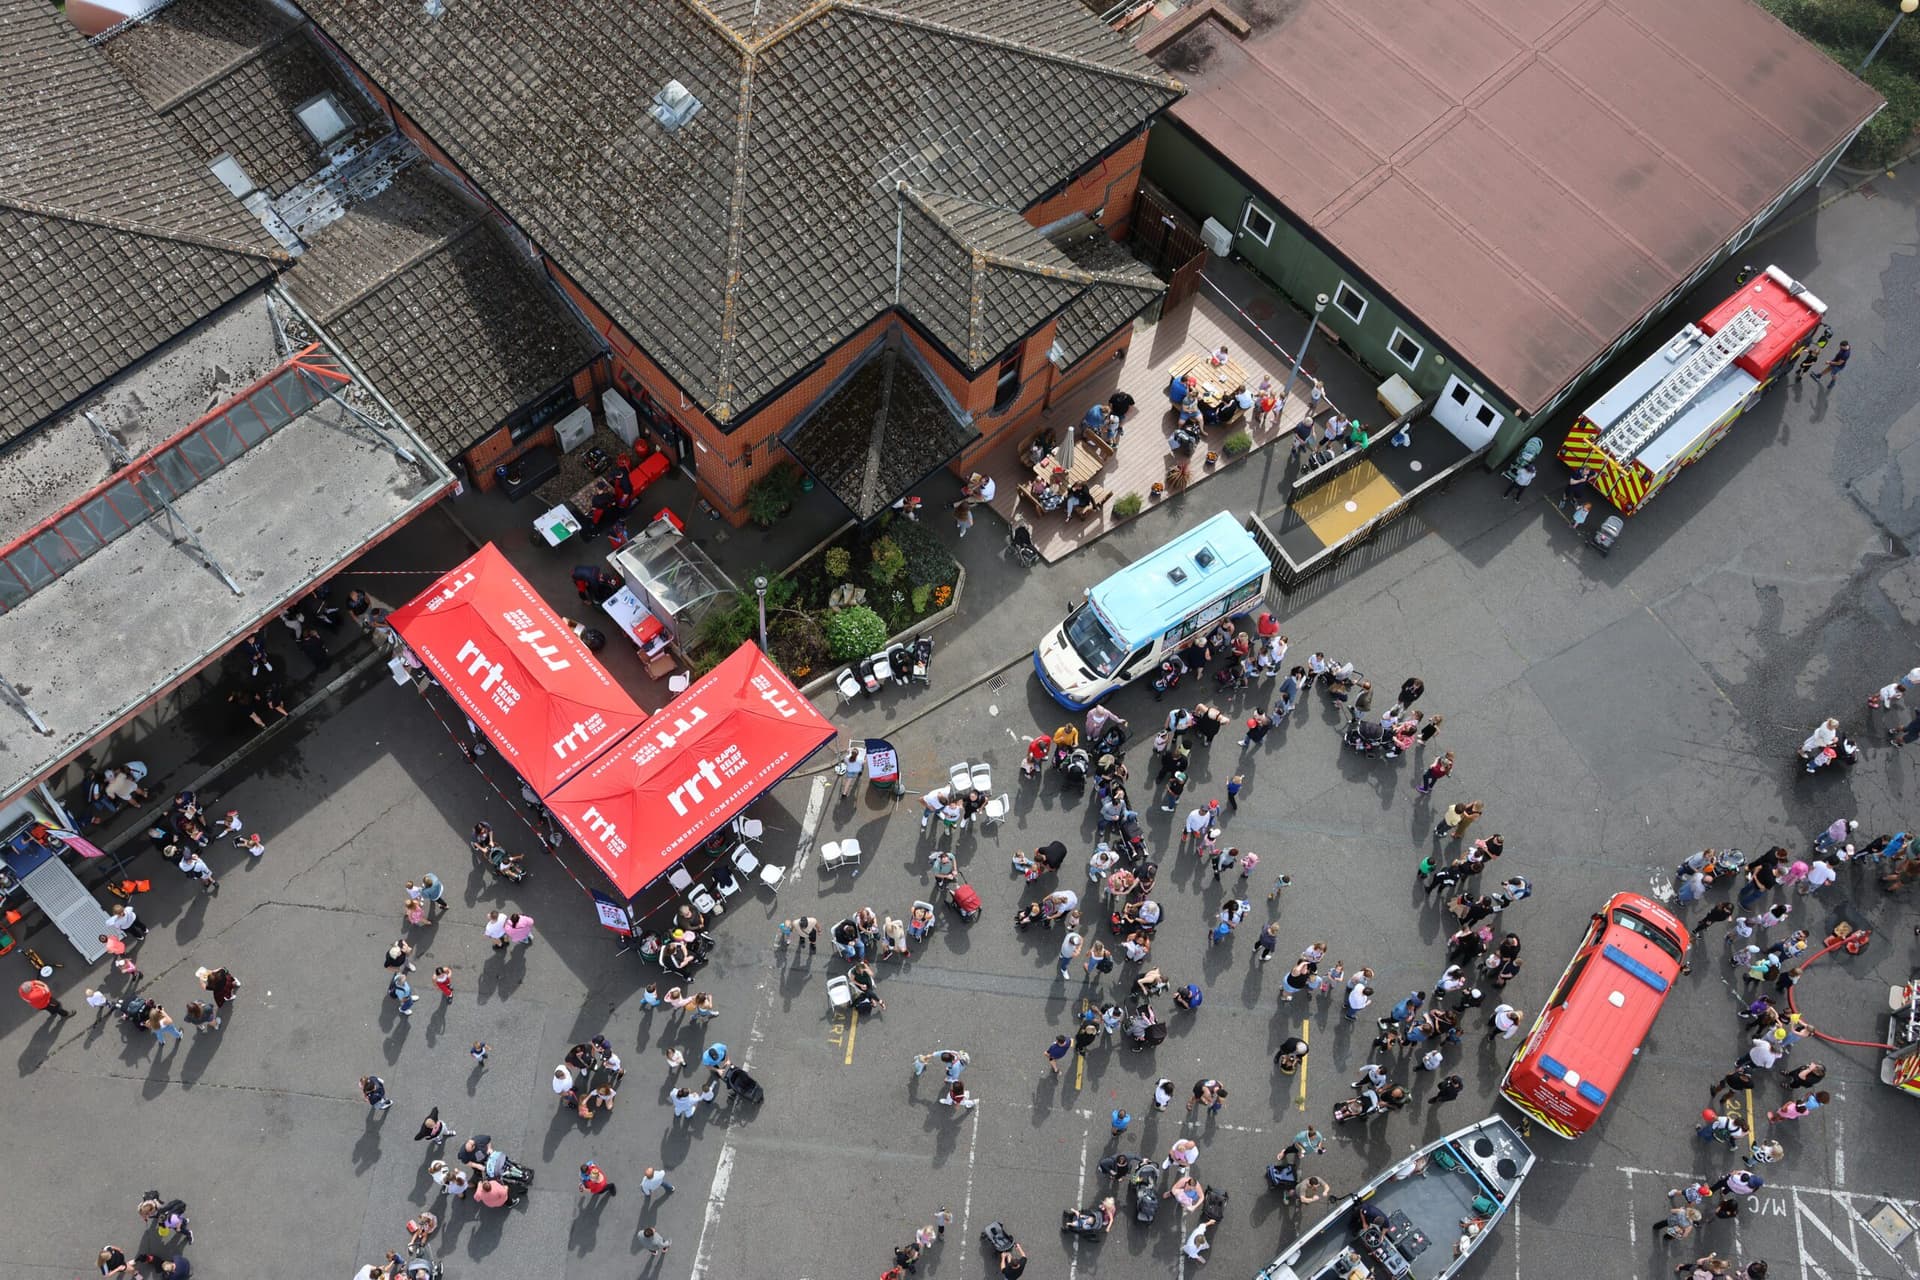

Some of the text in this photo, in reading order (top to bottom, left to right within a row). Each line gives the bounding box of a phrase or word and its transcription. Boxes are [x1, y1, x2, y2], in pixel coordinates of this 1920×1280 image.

[455, 640, 504, 692] rrt
[517, 630, 571, 672] rrt
[421, 645, 454, 682] COMMUNITY
[456, 686, 492, 726] COMPASSION
[493, 728, 520, 757] SUPPORT
[491, 693, 511, 715] TEAM
[495, 686, 516, 707] RELIEF
[501, 680, 521, 701] RAPID
[761, 689, 798, 718] rrt
[552, 722, 590, 760] rrt
[656, 706, 709, 749] rrt
[715, 744, 738, 765] RAPID
[719, 750, 742, 772] RELIEF
[724, 758, 748, 779] TEAM
[661, 751, 789, 856] COMMUNITY COMPASSION SUPPORT
[667, 758, 722, 817] rrt
[582, 806, 616, 842] rrt
[828, 1002, 849, 1048] ART
[1747, 1195, 1787, 1217] M/C
